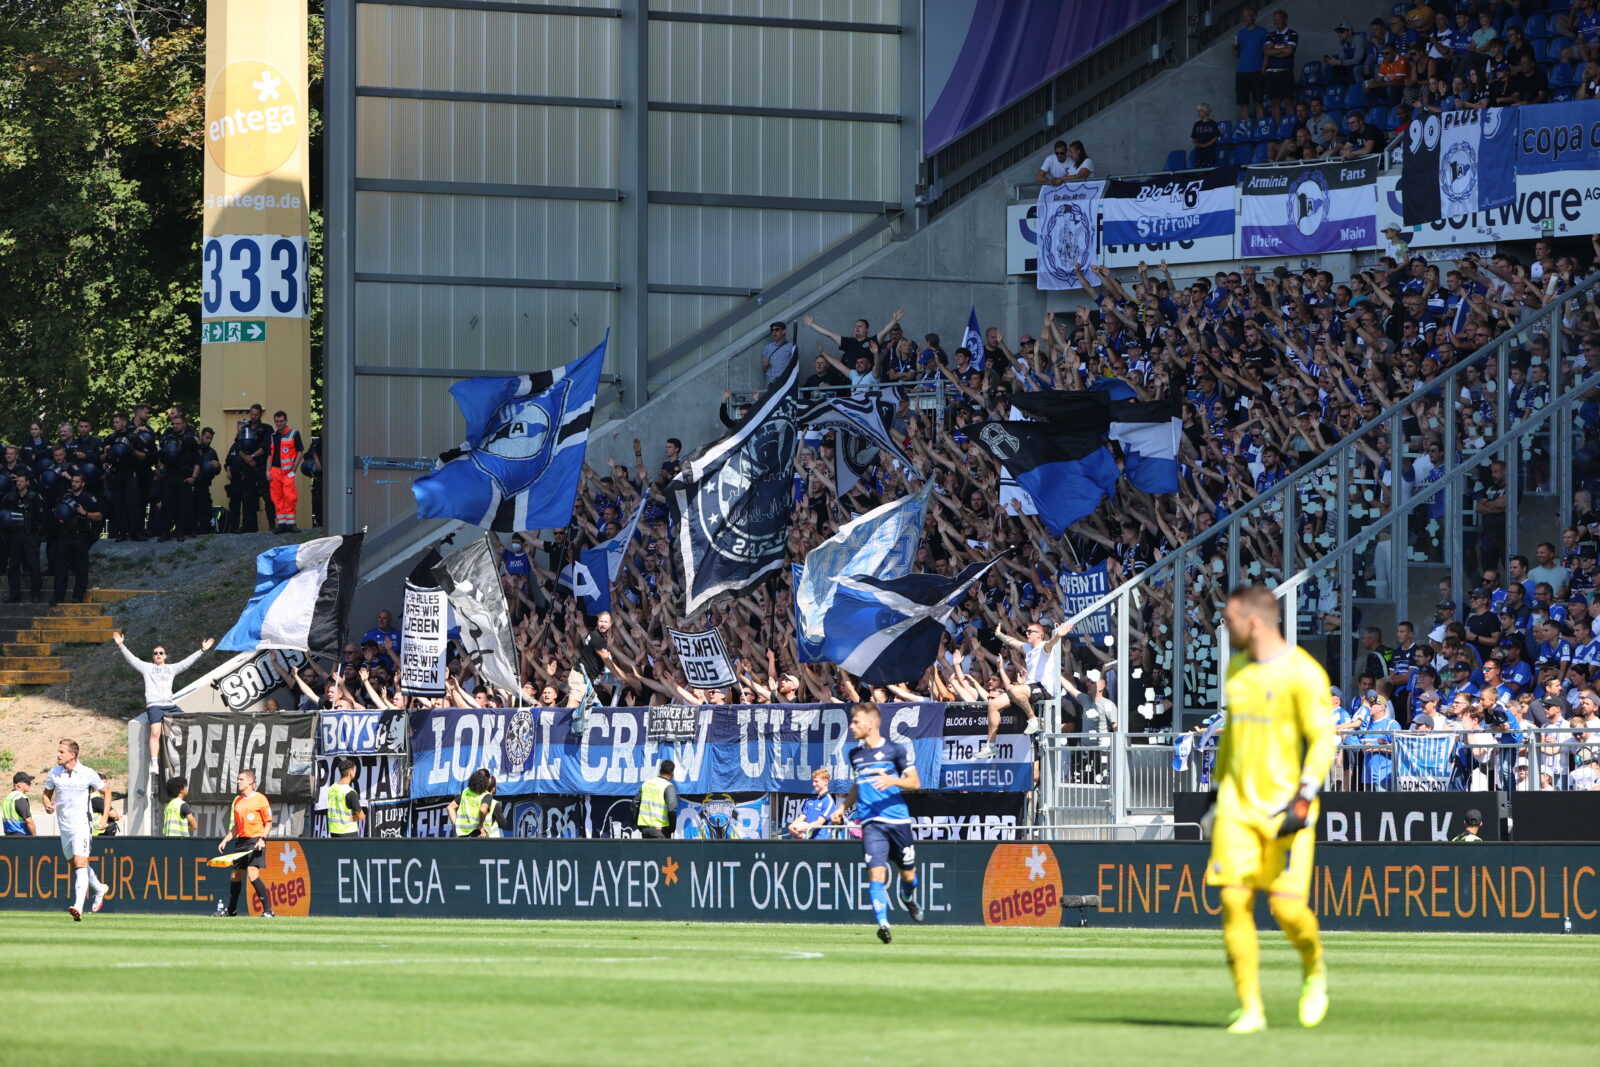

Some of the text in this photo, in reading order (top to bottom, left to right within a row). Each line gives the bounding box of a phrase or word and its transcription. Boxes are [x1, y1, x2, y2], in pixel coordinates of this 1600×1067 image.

[209, 104, 297, 142] entega
[1443, 108, 1480, 130] PLUS
[1522, 124, 1583, 161] copa
[1248, 168, 1366, 188] Arminia Fans
[216, 192, 300, 211] entega.de
[1183, 179, 1204, 210] 6
[1430, 188, 1582, 231] ware
[1251, 228, 1366, 247] Rhein- Main
[417, 594, 439, 605] ALLES
[422, 606, 439, 617] WIR
[420, 656, 439, 668] WIR
[684, 660, 720, 681] 1905
[682, 707, 695, 719] ALS
[945, 716, 966, 727] BLOCK
[967, 718, 973, 726] 6
[322, 714, 380, 751] BOYS
[428, 711, 562, 784] LOKL
[737, 705, 921, 781] ULTRS
[164, 722, 289, 795] SPENGE
[945, 740, 1014, 761] The Frm
[945, 769, 1014, 787] BIELEFELD
[1326, 811, 1453, 841] BLACK
[143, 857, 214, 901] ALLE.
[338, 859, 445, 904] ENTEGA
[691, 861, 740, 908] MIT
[1098, 864, 1222, 915] EINFAC
[989, 880, 1056, 922] entega
